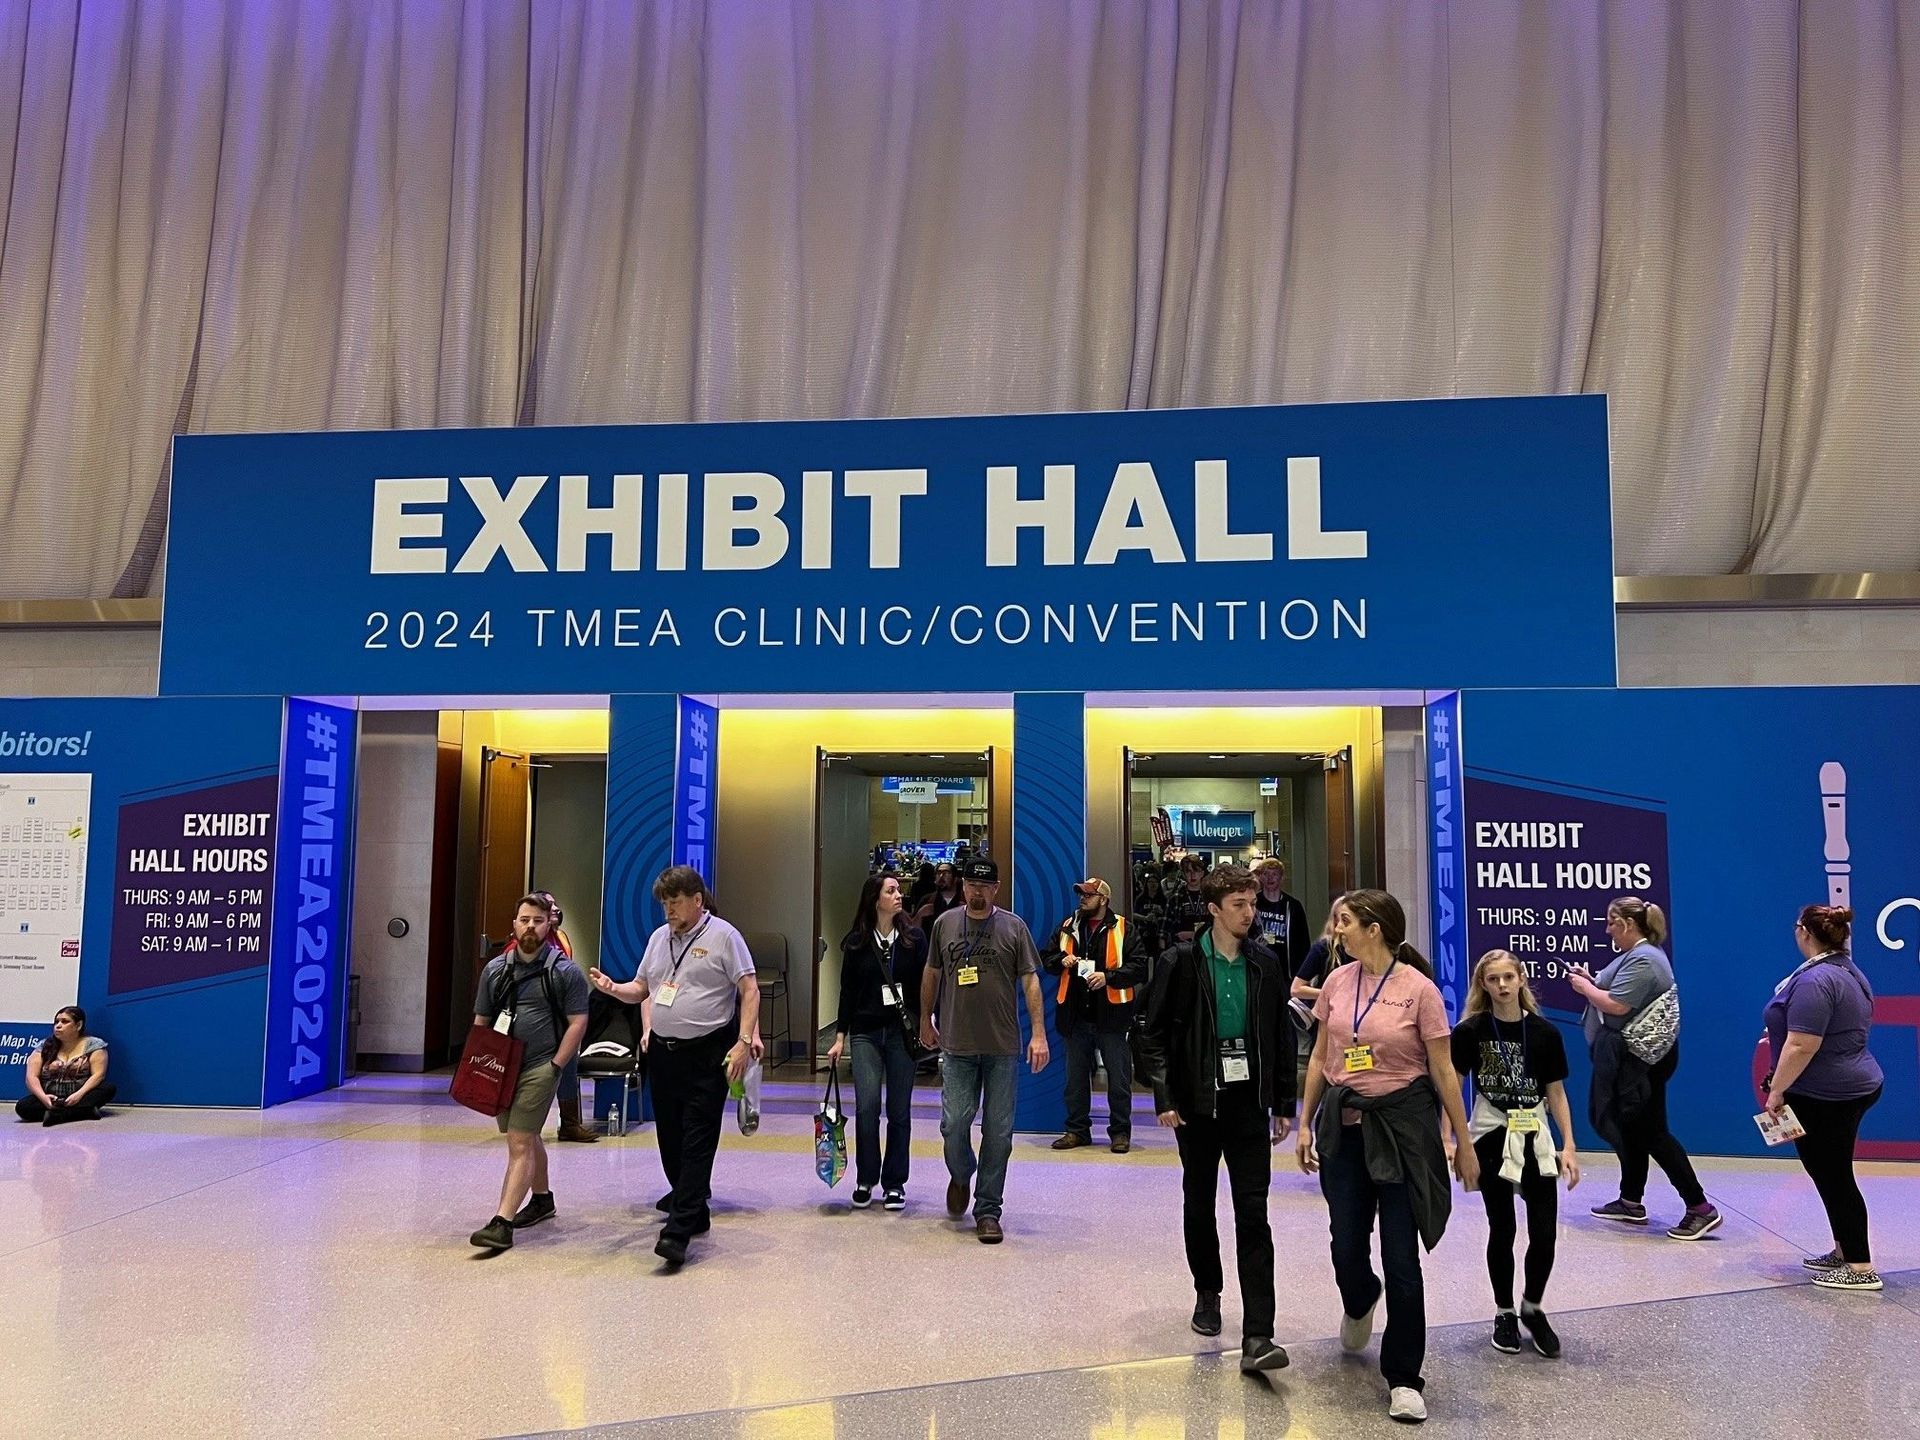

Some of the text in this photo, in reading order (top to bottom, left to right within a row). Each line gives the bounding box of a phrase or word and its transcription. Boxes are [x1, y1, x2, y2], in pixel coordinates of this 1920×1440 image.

[370, 456, 1368, 574] EXHIBIT HALL
[364, 598, 1366, 649] 2024 TMEA CLINIC/CONVENTION
[0, 730, 92, 756] bitors!
[183, 813, 271, 837] EXHIBIT
[1192, 818, 1244, 842] Wenger
[1475, 821, 1584, 848] EXHIBIT
[129, 848, 268, 873] HALL HOURS
[1433, 709, 1457, 1029] #TMEA20
[1476, 862, 1652, 890] HALL HOURS
[123, 889, 172, 905] THURS:
[176, 890, 185, 905] 9
[187, 889, 210, 905] AM
[227, 890, 236, 905] 5
[240, 889, 262, 905] PM
[288, 711, 338, 1085] #TMEA2024
[145, 913, 171, 929] FRI:
[174, 913, 184, 929] 9
[186, 913, 209, 929] AM
[226, 913, 235, 929] 6
[239, 913, 261, 929] PM
[1476, 907, 1540, 926] THURS:
[1545, 908, 1556, 926] 9
[1560, 908, 1588, 926] AM
[141, 936, 169, 952] SAT:
[173, 936, 182, 952] 9
[184, 936, 208, 952] AM
[226, 936, 232, 952] 1
[238, 936, 260, 952] PM
[1509, 935, 1541, 952] FRI:
[1546, 935, 1557, 952] 9
[1561, 935, 1589, 952] AM
[1520, 961, 1541, 979] AT:
[1546, 961, 1557, 979] 9
[0, 1034, 25, 1050] Map
